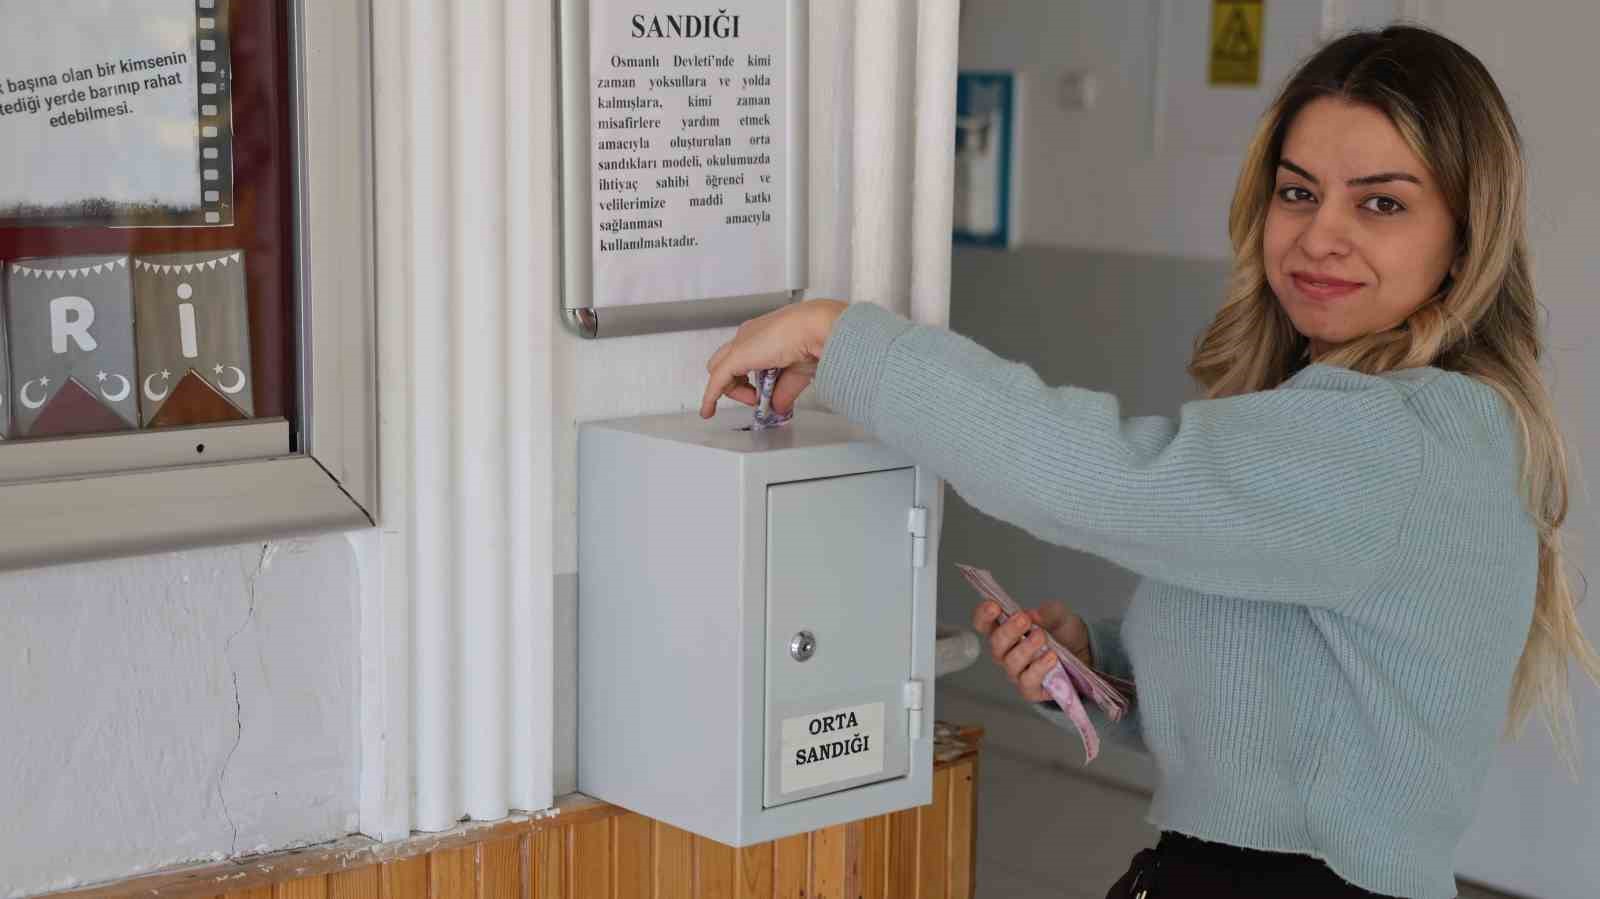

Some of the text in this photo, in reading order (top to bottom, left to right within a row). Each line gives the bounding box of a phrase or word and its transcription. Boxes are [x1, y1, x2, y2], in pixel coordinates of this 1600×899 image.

[631, 8, 740, 38] SANDIĞI
[611, 54, 771, 68] Osmanlı Devleti'nde kimi
[7, 73, 58, 95] başına
[61, 66, 93, 84] olan
[96, 61, 117, 79] bir
[119, 51, 188, 74] kimsenin
[597, 74, 771, 90] zaman yoksullara ve yolda
[45, 90, 87, 111] yerde
[90, 82, 141, 101] barınıp
[144, 71, 183, 89] rahat
[598, 95, 771, 111] kalmışlara, kimi zaman
[49, 101, 135, 128] edebilmesi.
[598, 115, 771, 130] misafirlere yardım etmek
[598, 135, 771, 152] amacıyla oluşturulan orta
[598, 155, 771, 171] sandıkları modeli, okulumuzda
[599, 174, 771, 193] ihtiyaç sahibi öğrenci ve
[599, 191, 771, 211] velilerimize maddi katkı
[599, 211, 771, 234] sağlanması amacıyla
[599, 236, 699, 252] kullanılmaktadır.
[809, 711, 858, 735] ORTA
[796, 733, 869, 766] SANDIĞI
